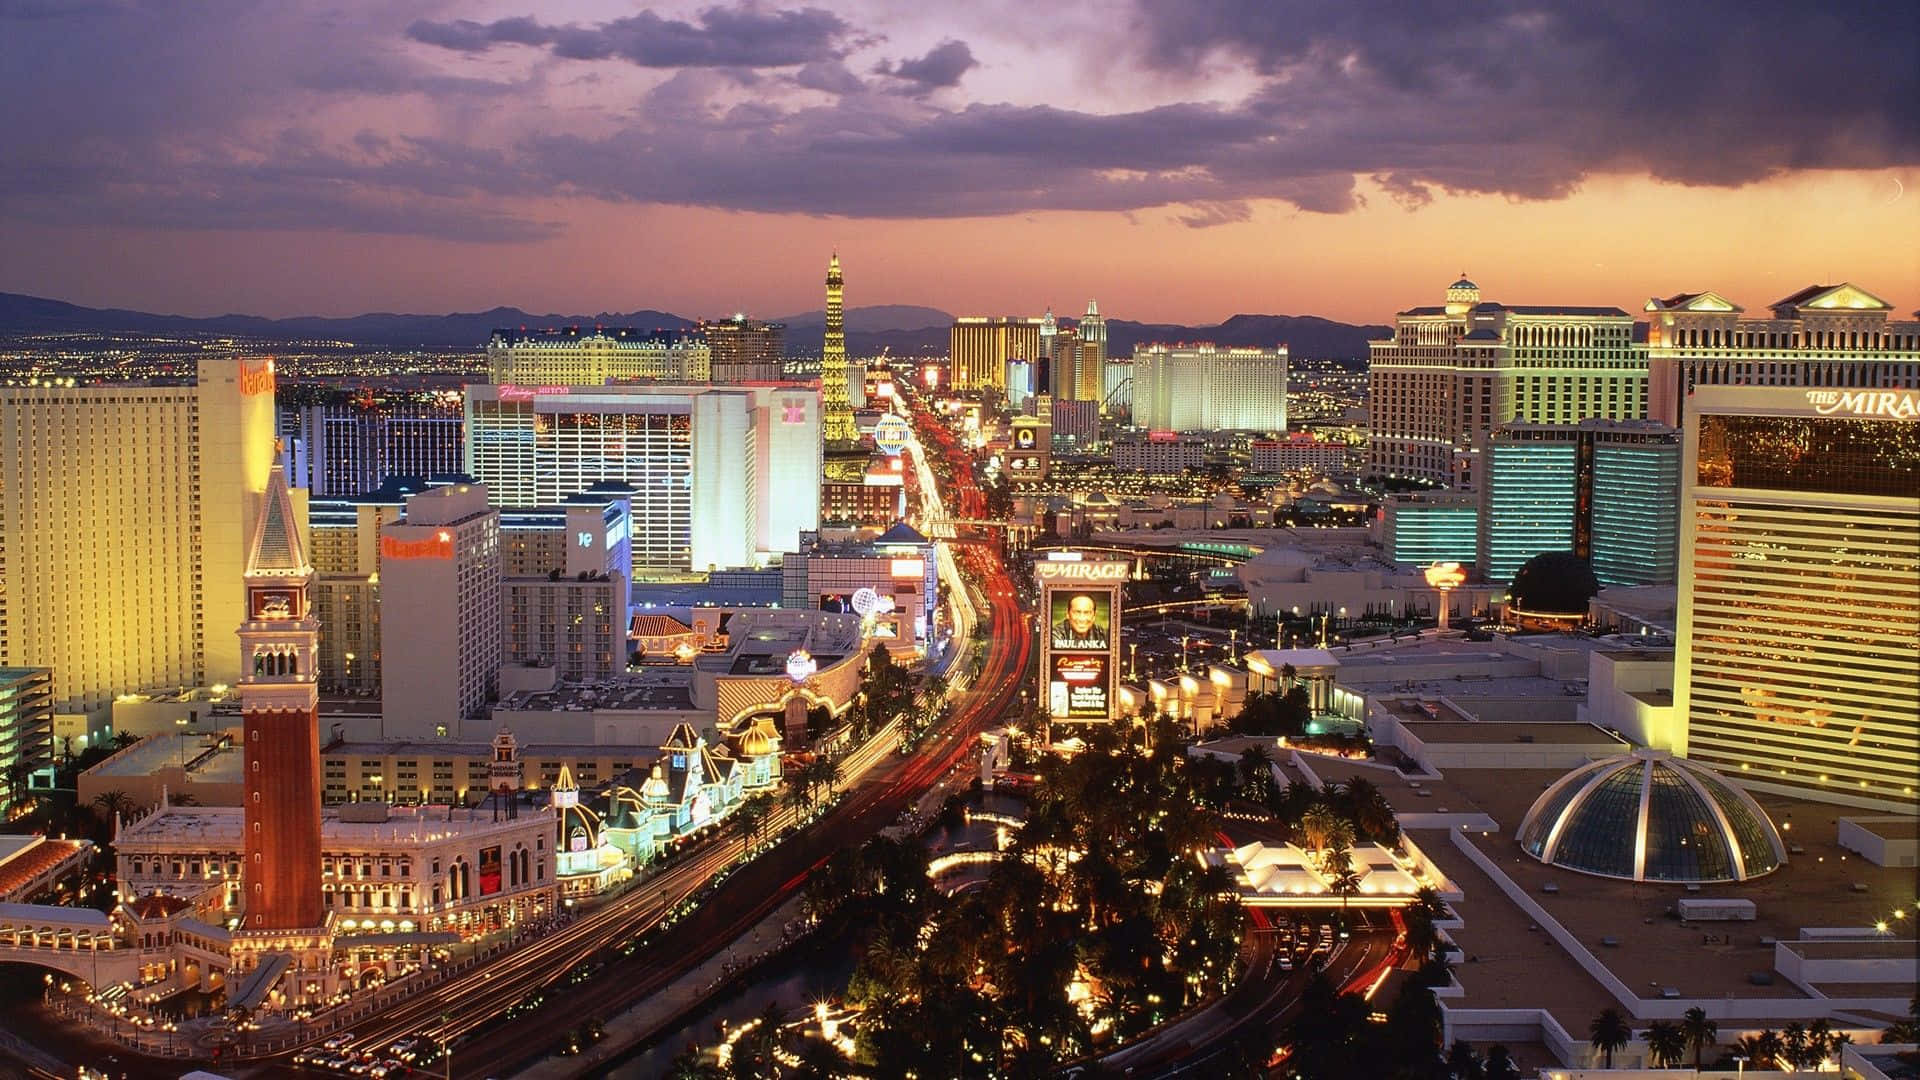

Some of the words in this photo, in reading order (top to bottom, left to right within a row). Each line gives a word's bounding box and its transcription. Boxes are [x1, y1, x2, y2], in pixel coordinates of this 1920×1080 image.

[866, 371, 892, 380] MGM
[1806, 391, 1839, 404] THE
[1816, 391, 1920, 419] MIRA
[1042, 563, 1127, 580] MIRAGE
[1055, 640, 1077, 649] PAUL
[1078, 640, 1107, 649] ANKA
